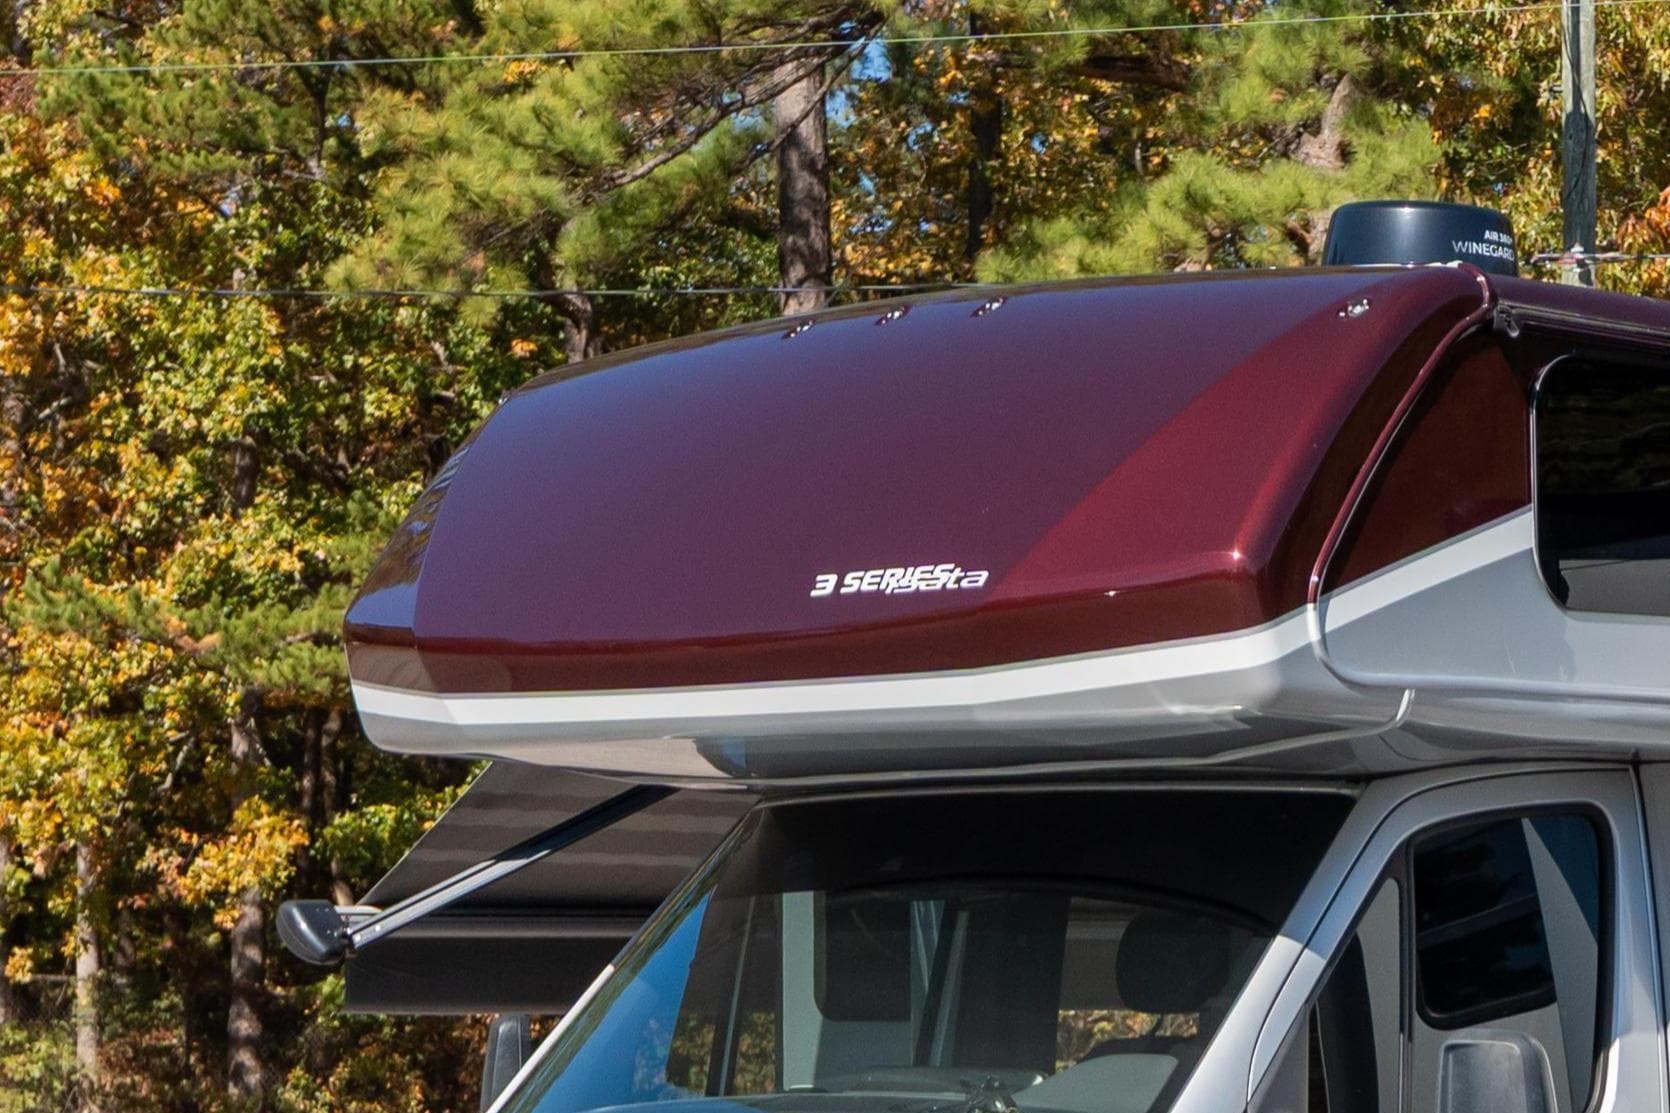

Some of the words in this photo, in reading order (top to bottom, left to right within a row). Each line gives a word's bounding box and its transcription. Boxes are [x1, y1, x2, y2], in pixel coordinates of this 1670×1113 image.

[1485, 230, 1499, 241] AIR
[1452, 240, 1515, 261] WINEGARD
[811, 574, 837, 597] 3
